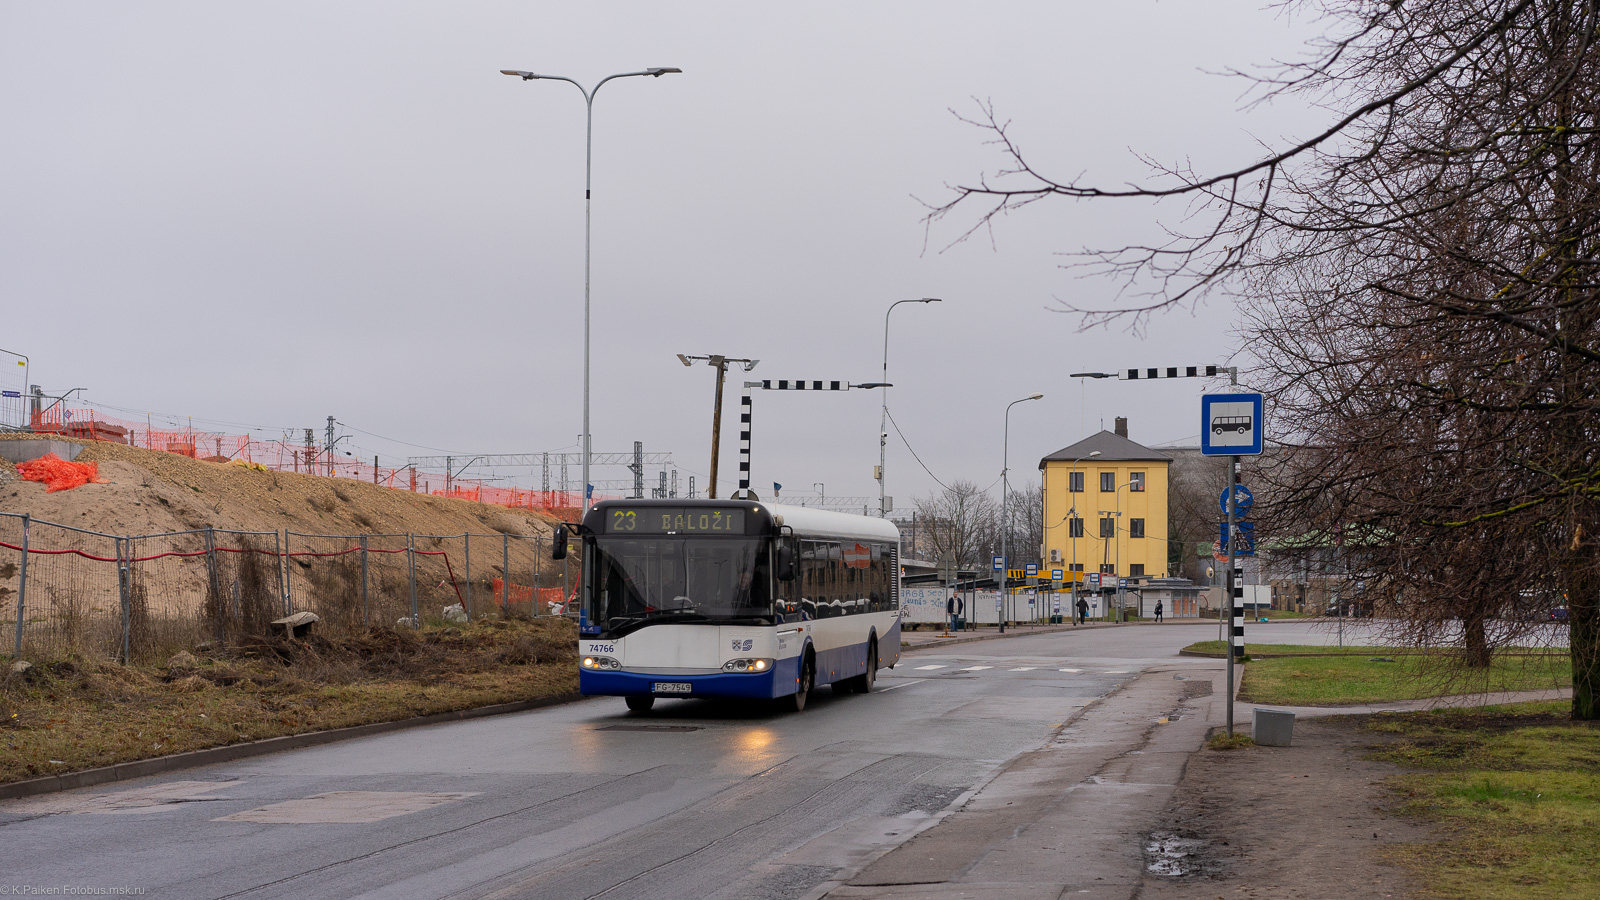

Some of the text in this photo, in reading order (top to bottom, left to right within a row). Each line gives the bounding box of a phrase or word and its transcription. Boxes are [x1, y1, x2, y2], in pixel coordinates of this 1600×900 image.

[613, 510, 732, 531] 23 BALOŽI
[589, 644, 615, 653] 74766
[656, 683, 691, 691] FG-7549
